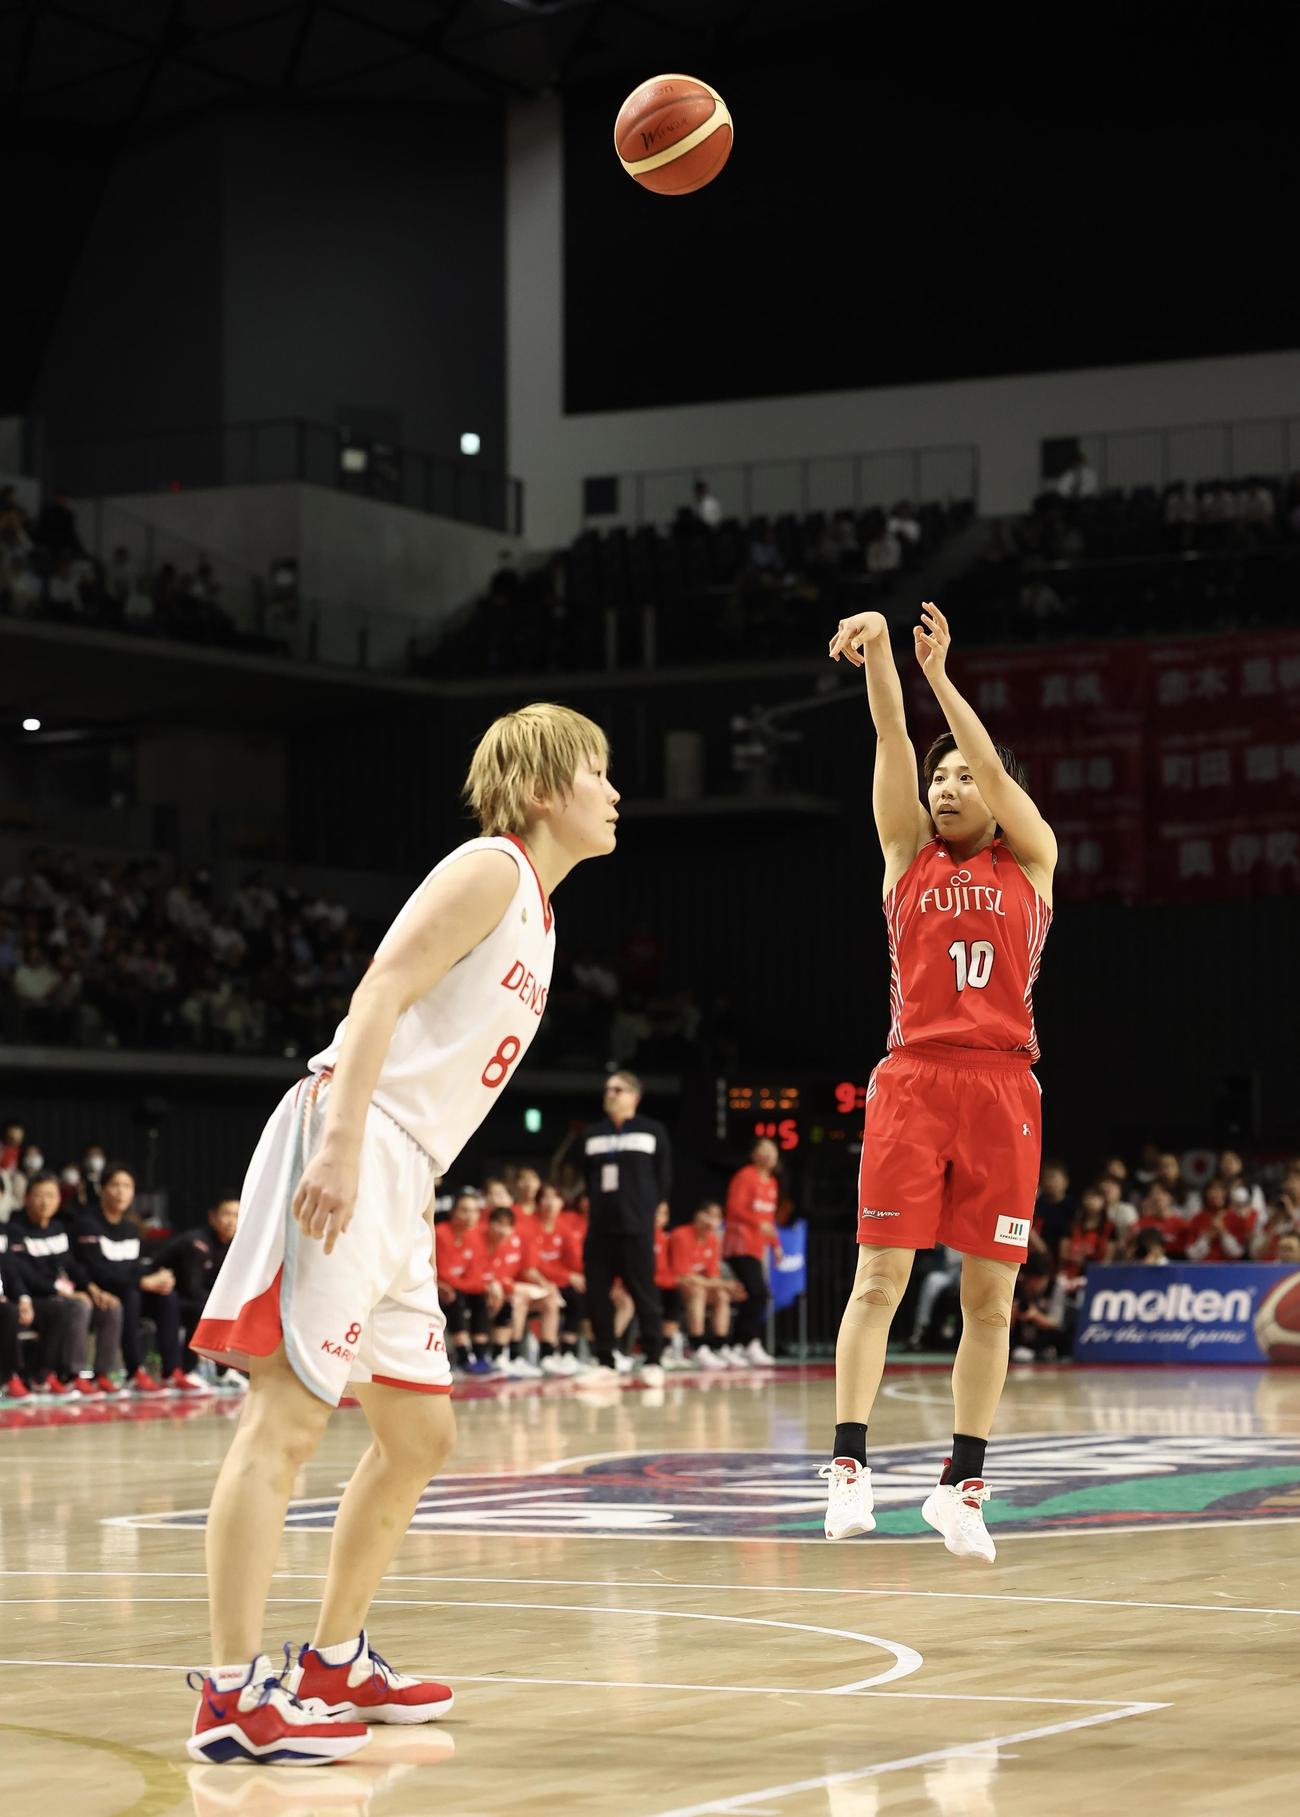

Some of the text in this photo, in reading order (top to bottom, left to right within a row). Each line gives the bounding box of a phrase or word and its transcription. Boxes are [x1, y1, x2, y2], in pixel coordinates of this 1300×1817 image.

[948, 940, 995, 992] 10
[481, 1035, 521, 1088] 8
[1090, 1284, 1251, 1323] molten
[345, 1322, 361, 1344] 8
